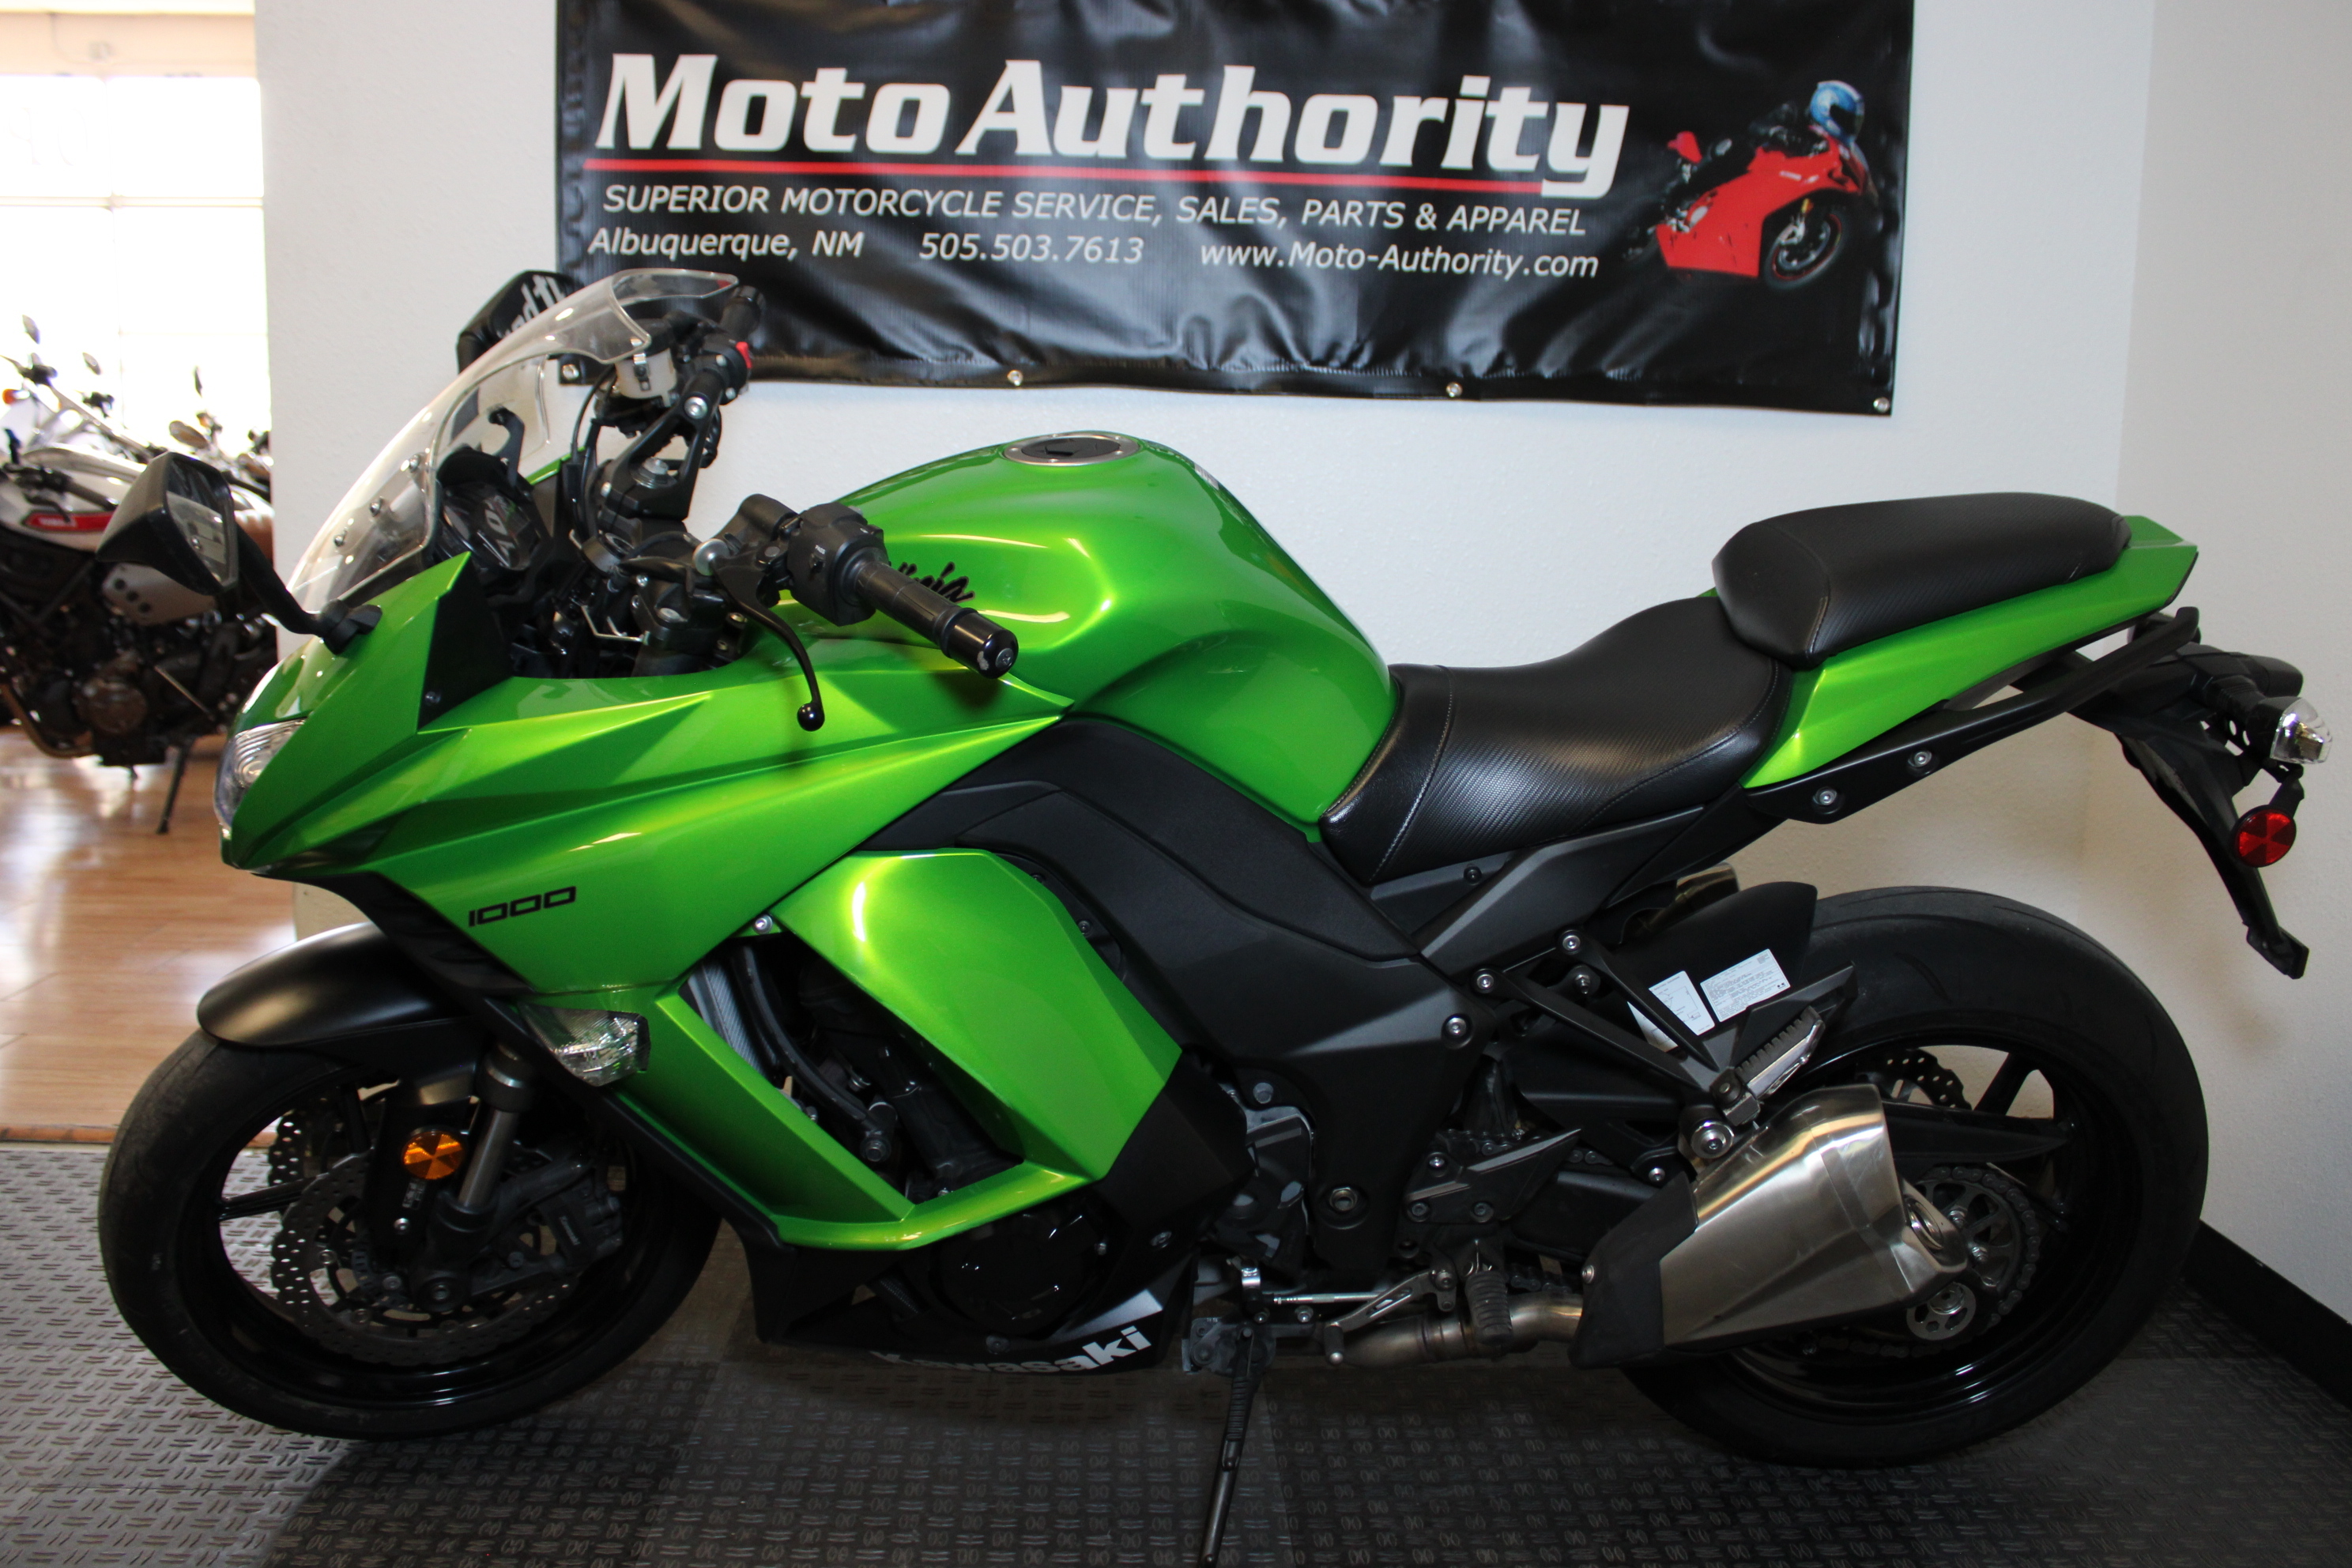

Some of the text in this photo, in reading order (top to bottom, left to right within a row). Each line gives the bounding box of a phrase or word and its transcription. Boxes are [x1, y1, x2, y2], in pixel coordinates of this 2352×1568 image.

[596, 53, 1630, 198] Moto Authority
[603, 184, 1587, 236] SUPERIOR MOTORCYCLE SERVICE, SALES, PARTS & APPAREL
[587, 227, 865, 262] Albuquerque, NM
[918, 232, 1145, 264] 505.503.7613
[1200, 240, 1600, 281] www.Moto-Authority.com
[468, 885, 577, 928] 1000
